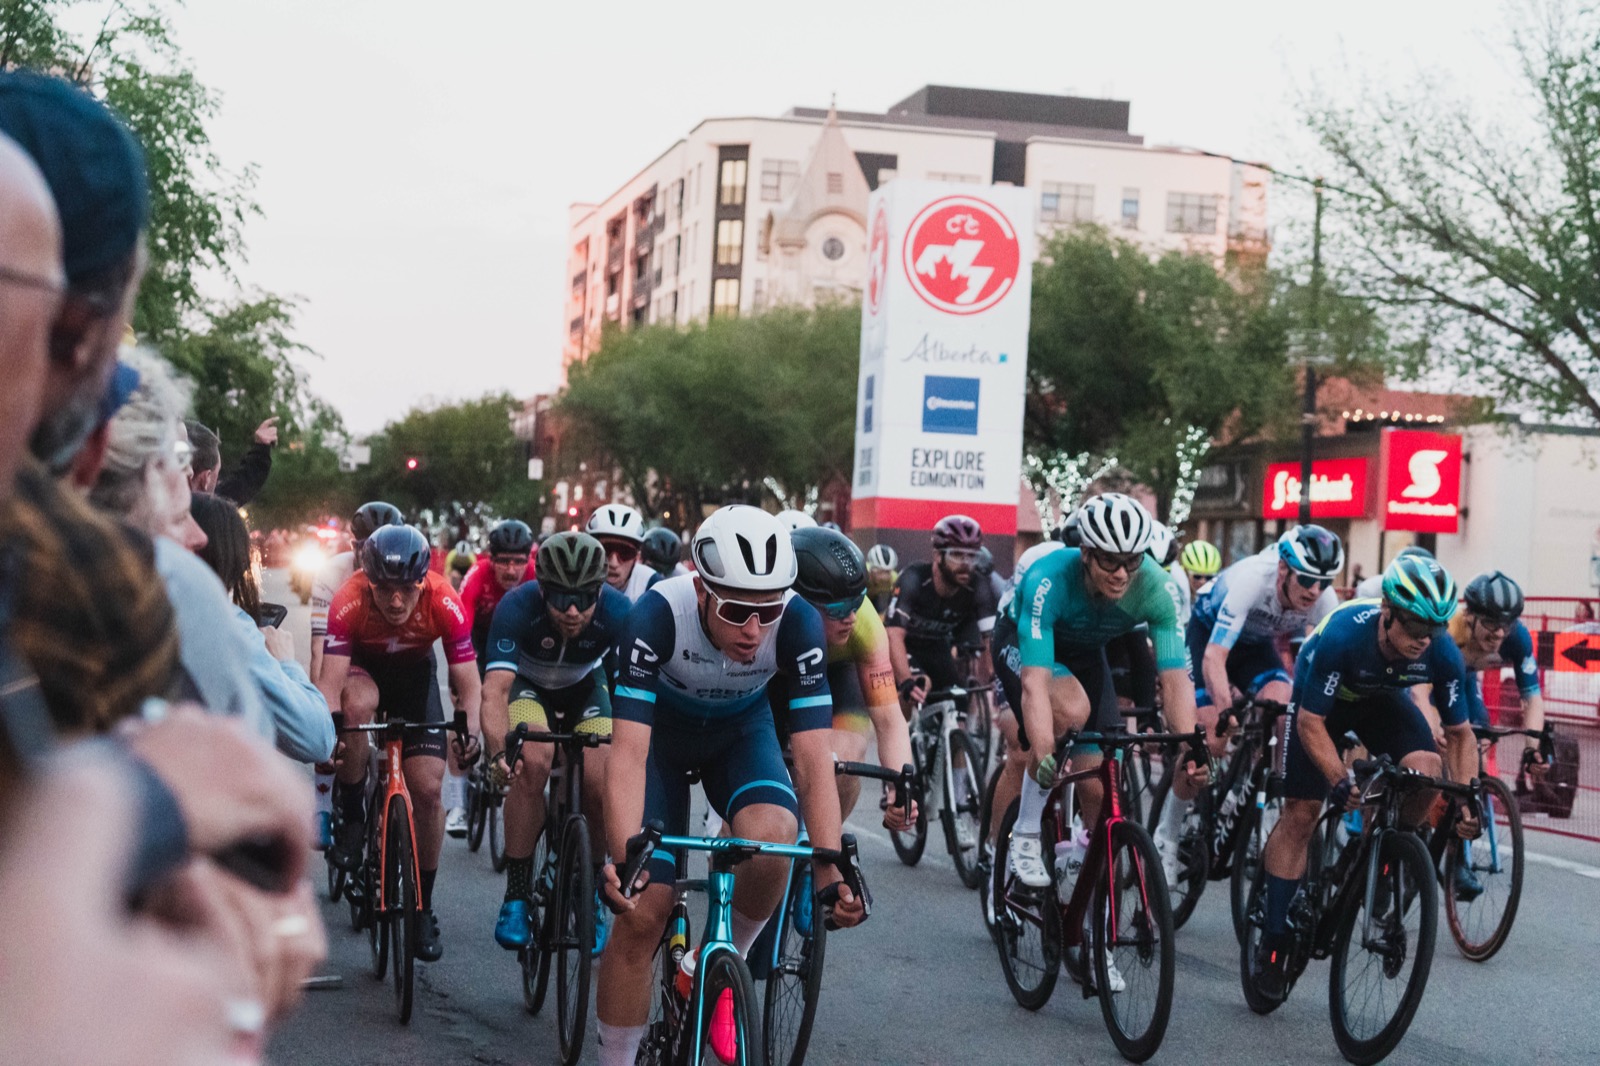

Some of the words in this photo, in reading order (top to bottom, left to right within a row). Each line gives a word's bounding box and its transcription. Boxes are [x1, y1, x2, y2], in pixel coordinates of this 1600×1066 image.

[902, 333, 994, 363] Alberta
[912, 448, 985, 471] EXPLORE
[911, 470, 985, 489] EDMONTON
[442, 596, 465, 625] Optum
[1031, 577, 1053, 617] WORLD
[630, 670, 645, 678] TECH
[1281, 714, 1293, 780] spidertech
